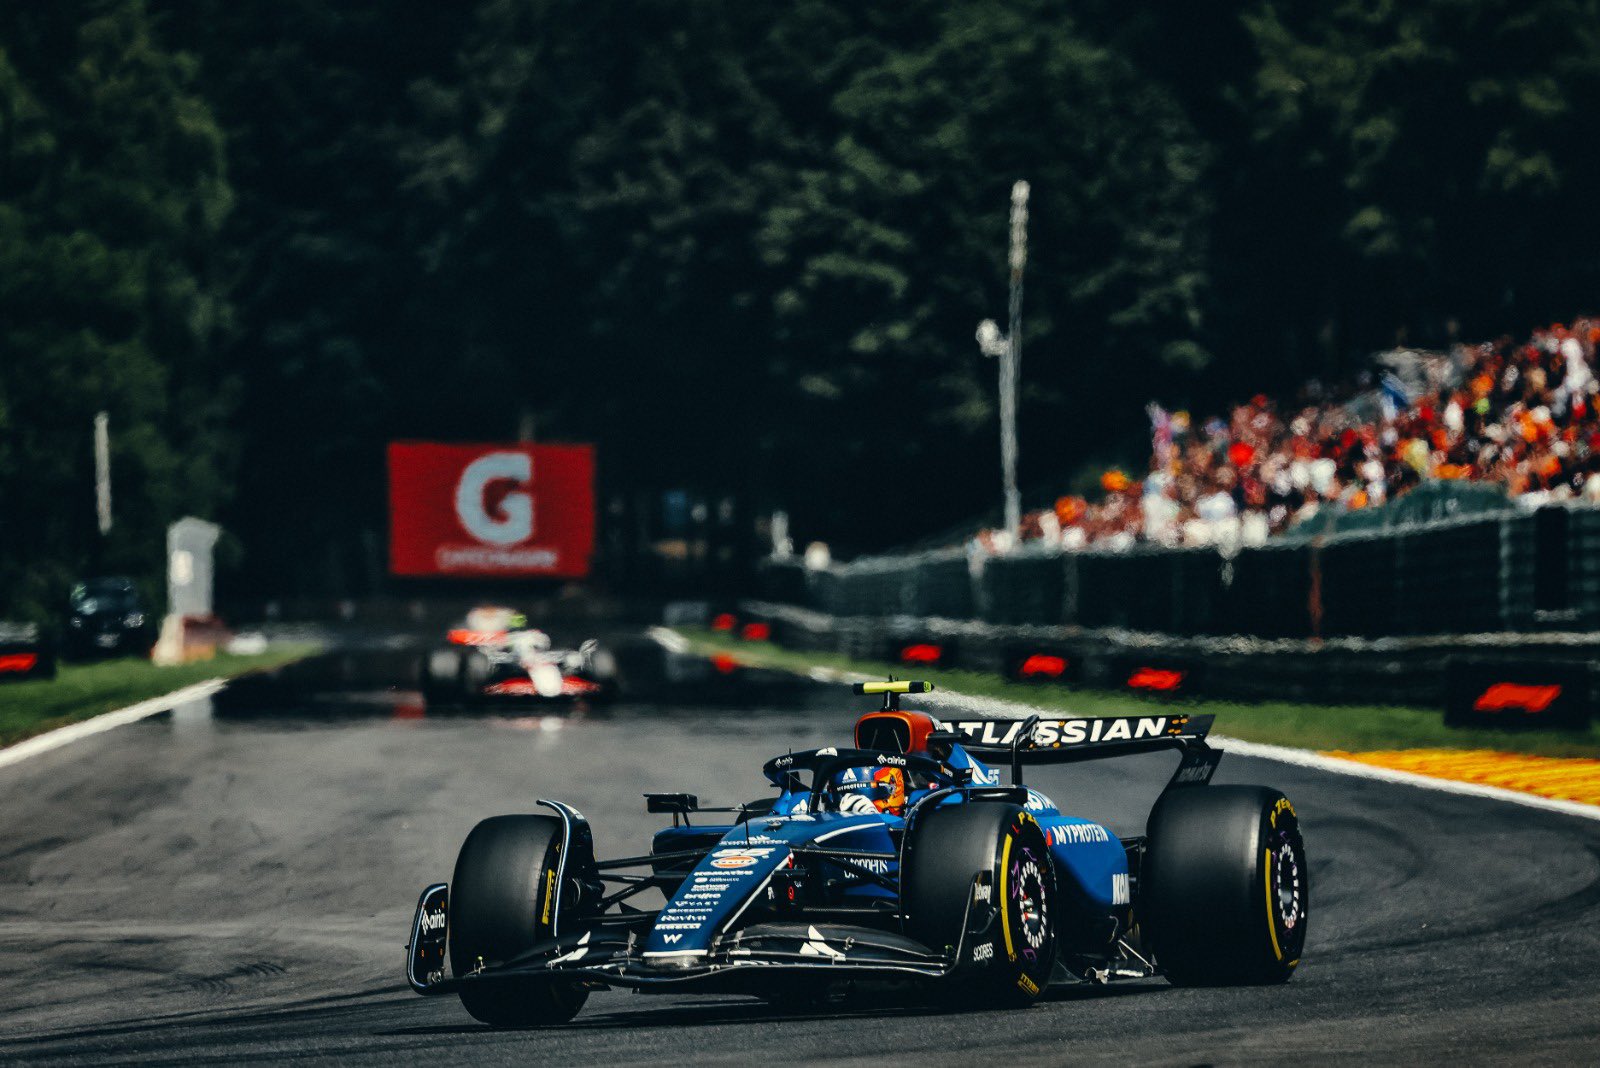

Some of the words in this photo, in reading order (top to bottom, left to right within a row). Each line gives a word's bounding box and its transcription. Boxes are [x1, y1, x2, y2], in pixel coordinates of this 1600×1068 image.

[455, 452, 533, 545] G
[887, 756, 906, 766] airia
[1052, 824, 1109, 845] MYPROTEIN
[430, 909, 446, 929] airia
